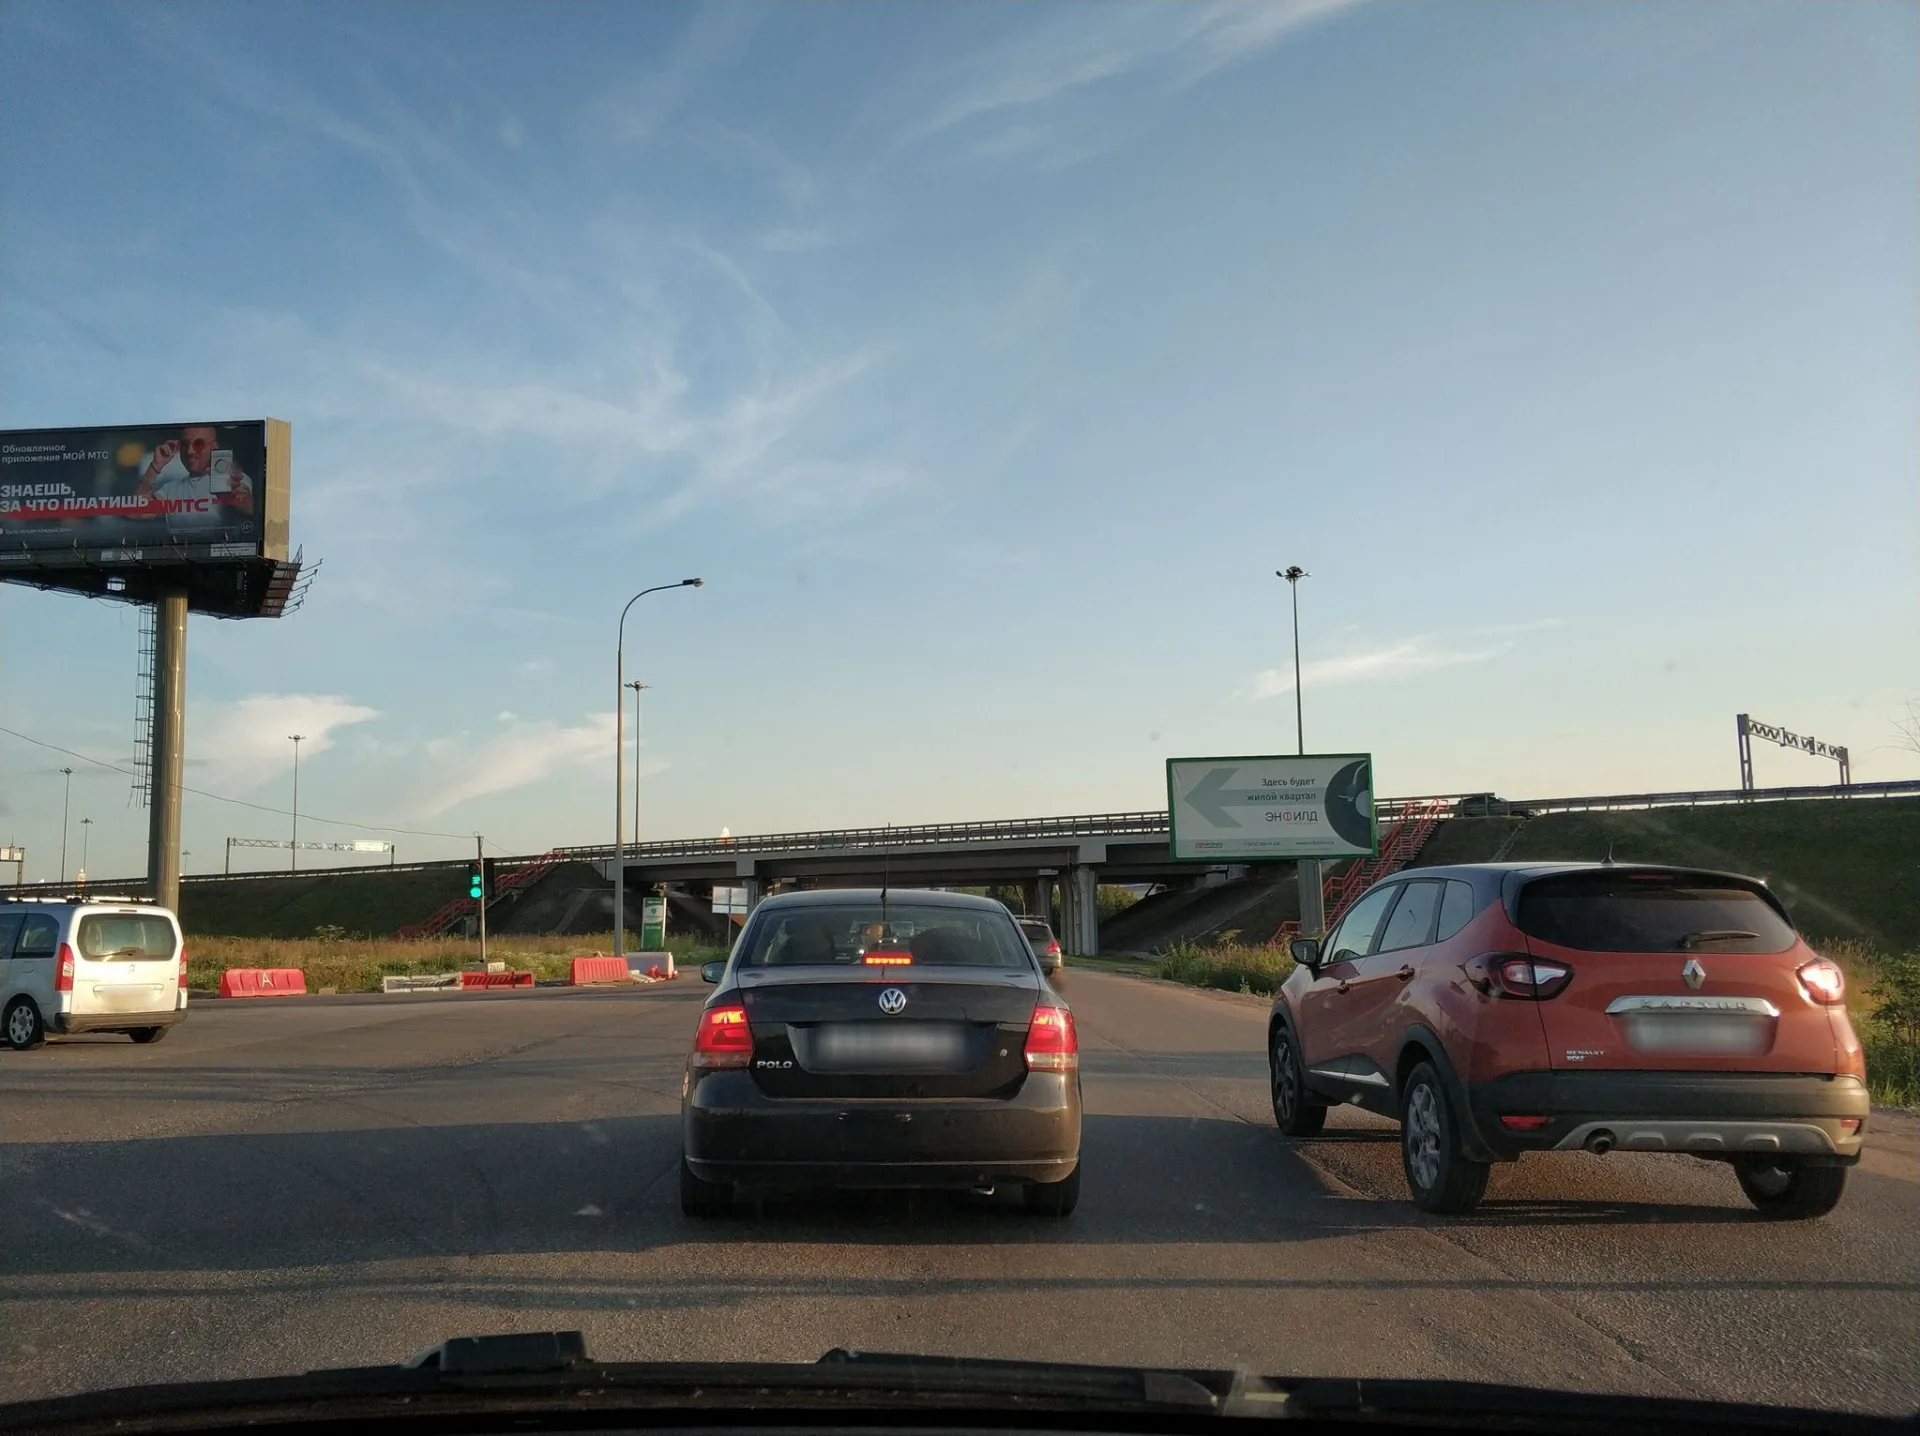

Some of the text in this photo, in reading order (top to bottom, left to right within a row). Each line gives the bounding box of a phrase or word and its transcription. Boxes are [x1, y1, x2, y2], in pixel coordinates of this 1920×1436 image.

[2, 444, 66, 454] Обновленное
[2, 450, 109, 464] приложение МОЙ МТС
[0, 483, 76, 497] ЗНАЕШЬ,
[0, 495, 149, 513] ЗА ЧТО ПЛАТИШЬ
[166, 498, 209, 513] МТС
[1261, 777, 1316, 787] Здесь будет
[1247, 791, 1316, 802] жилой квартал
[1264, 810, 1318, 822] ЭНФИЛД
[1641, 1000, 1748, 1011] KAPTUR
[756, 1060, 793, 1069] POLO
